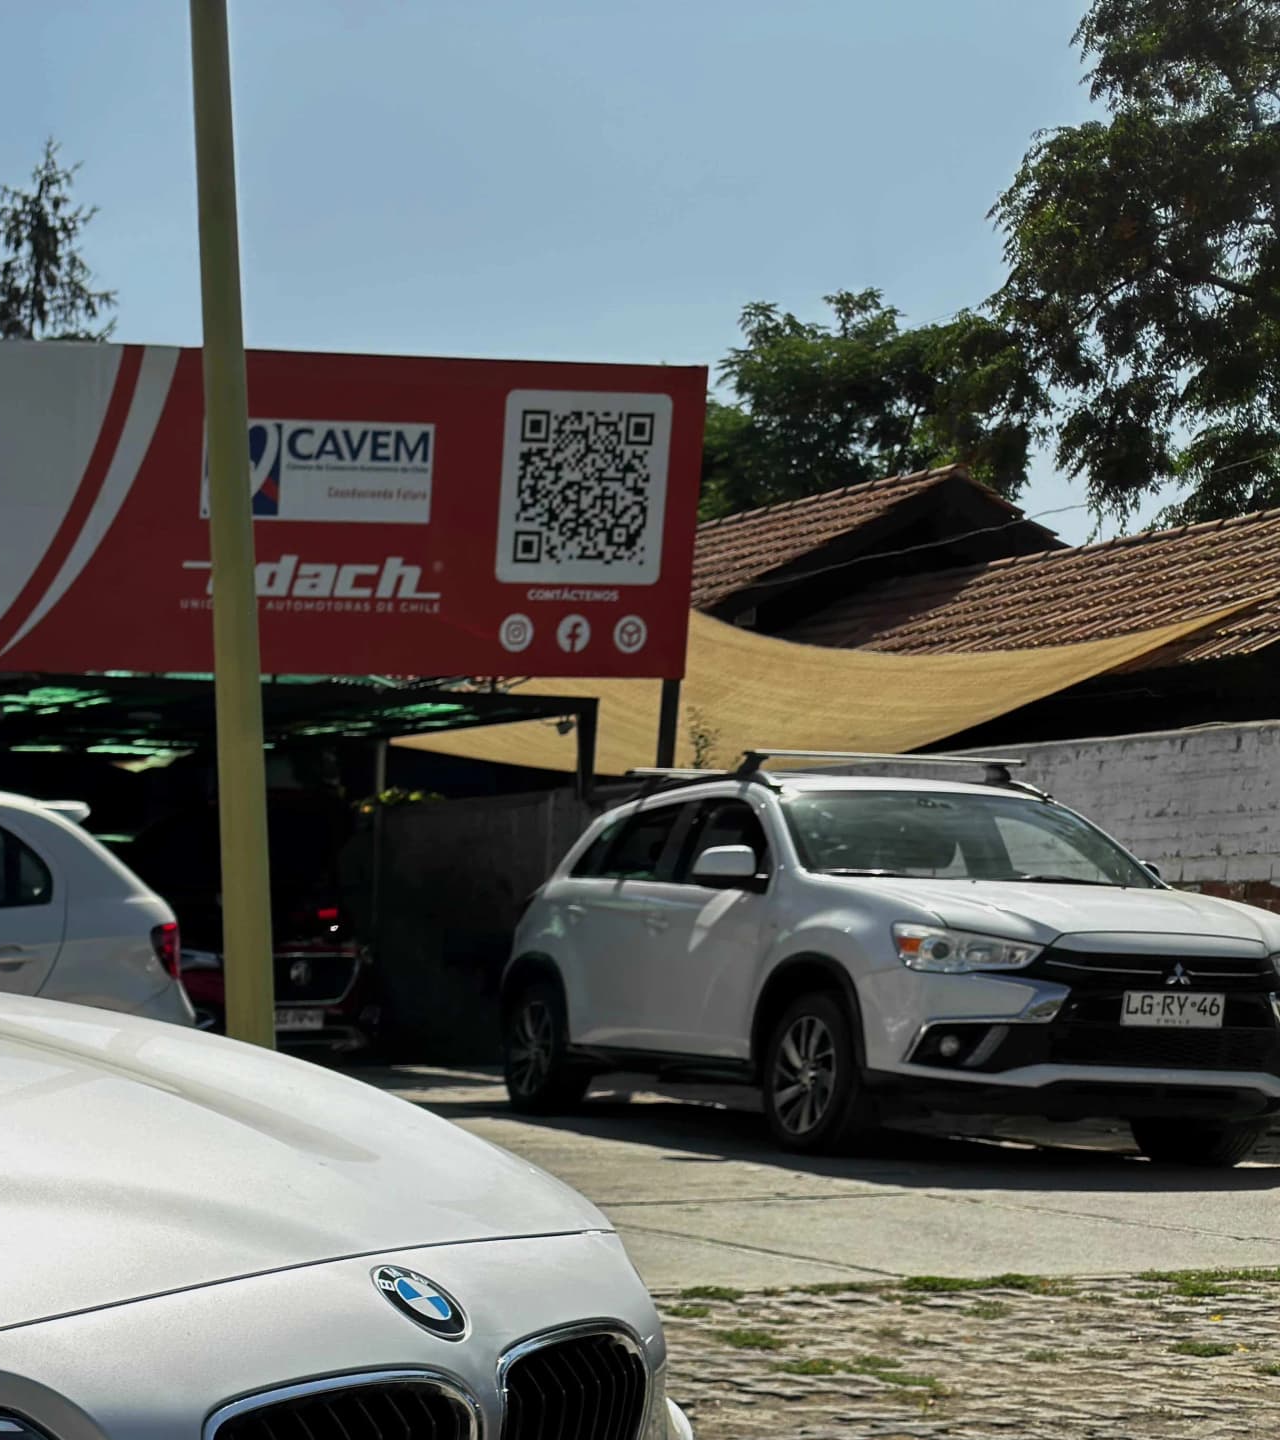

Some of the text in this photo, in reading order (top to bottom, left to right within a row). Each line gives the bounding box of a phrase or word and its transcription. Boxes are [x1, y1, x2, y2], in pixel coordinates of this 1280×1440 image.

[287, 428, 429, 462] CAVEM
[376, 602, 393, 612] DE
[399, 601, 440, 614] CHILE
